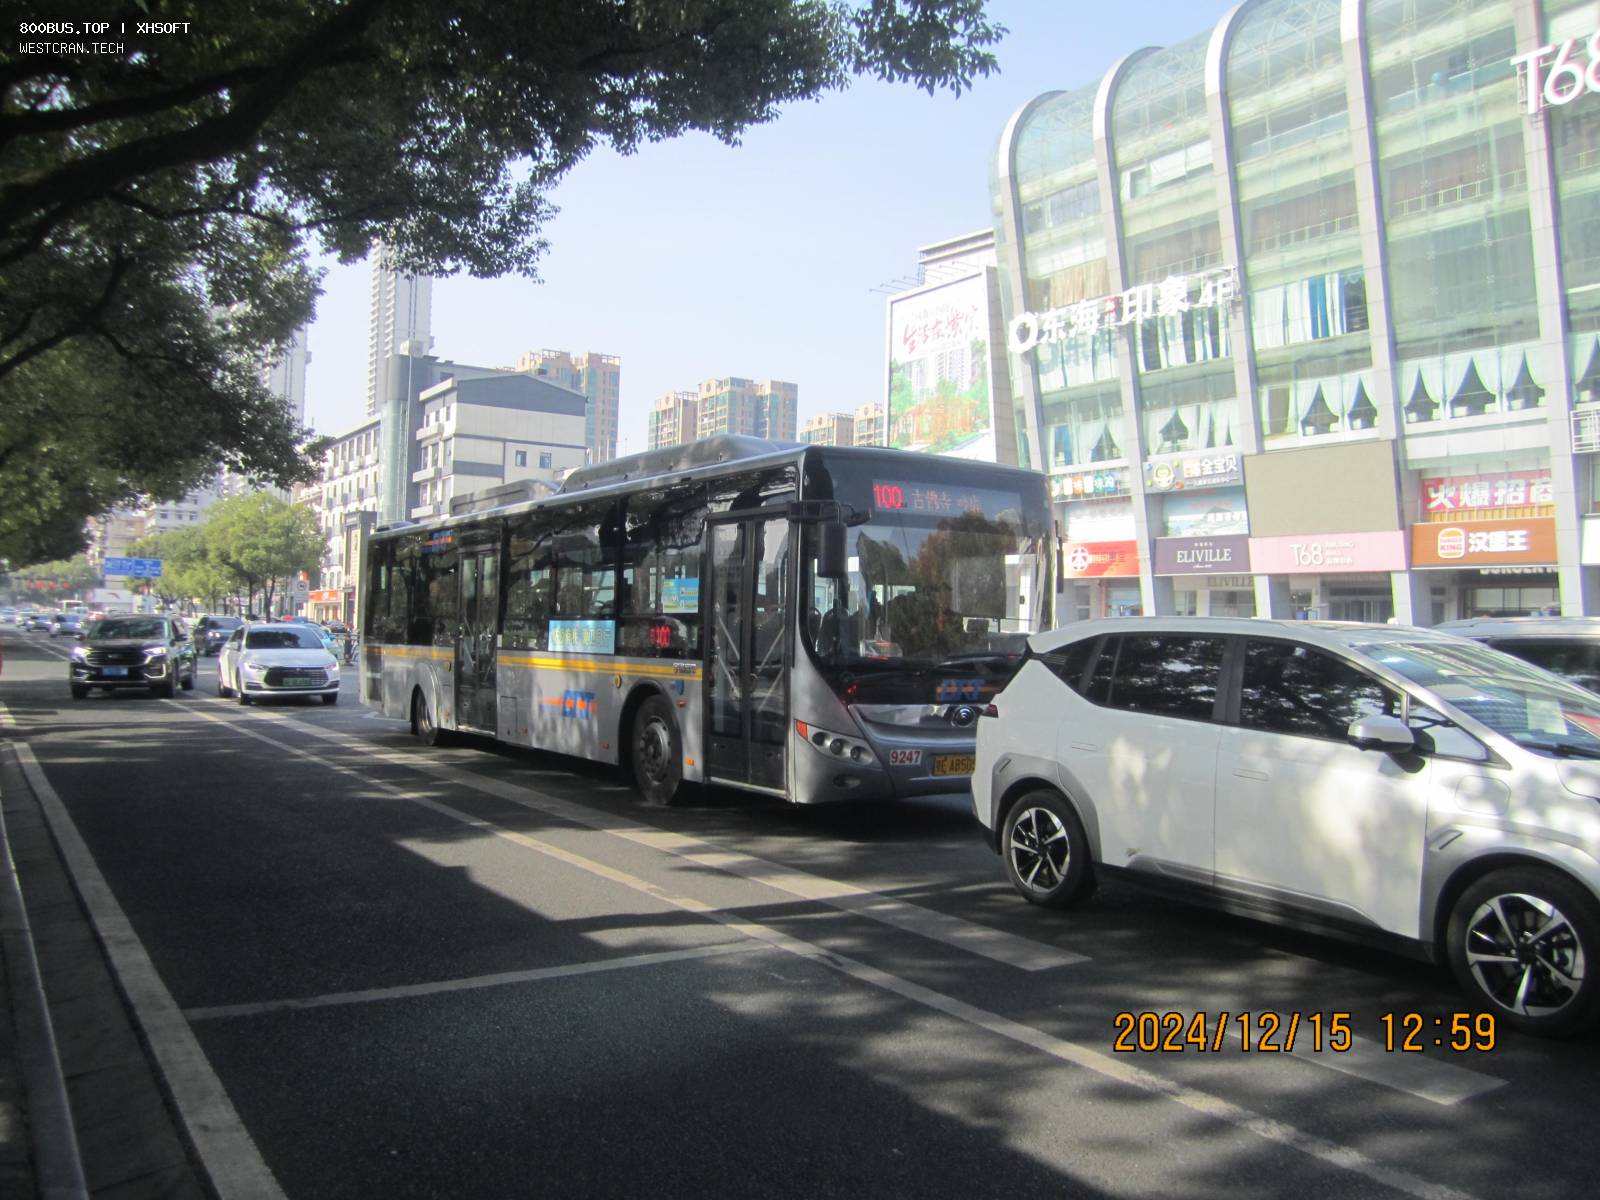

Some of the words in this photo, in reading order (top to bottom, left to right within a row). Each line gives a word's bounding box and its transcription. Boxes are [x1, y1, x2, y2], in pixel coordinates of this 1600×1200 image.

[1468, 530, 1528, 553] 汉堡王
[1176, 548, 1232, 563] ELIVILLE
[1289, 543, 1324, 566] T68
[891, 750, 921, 764] 9247
